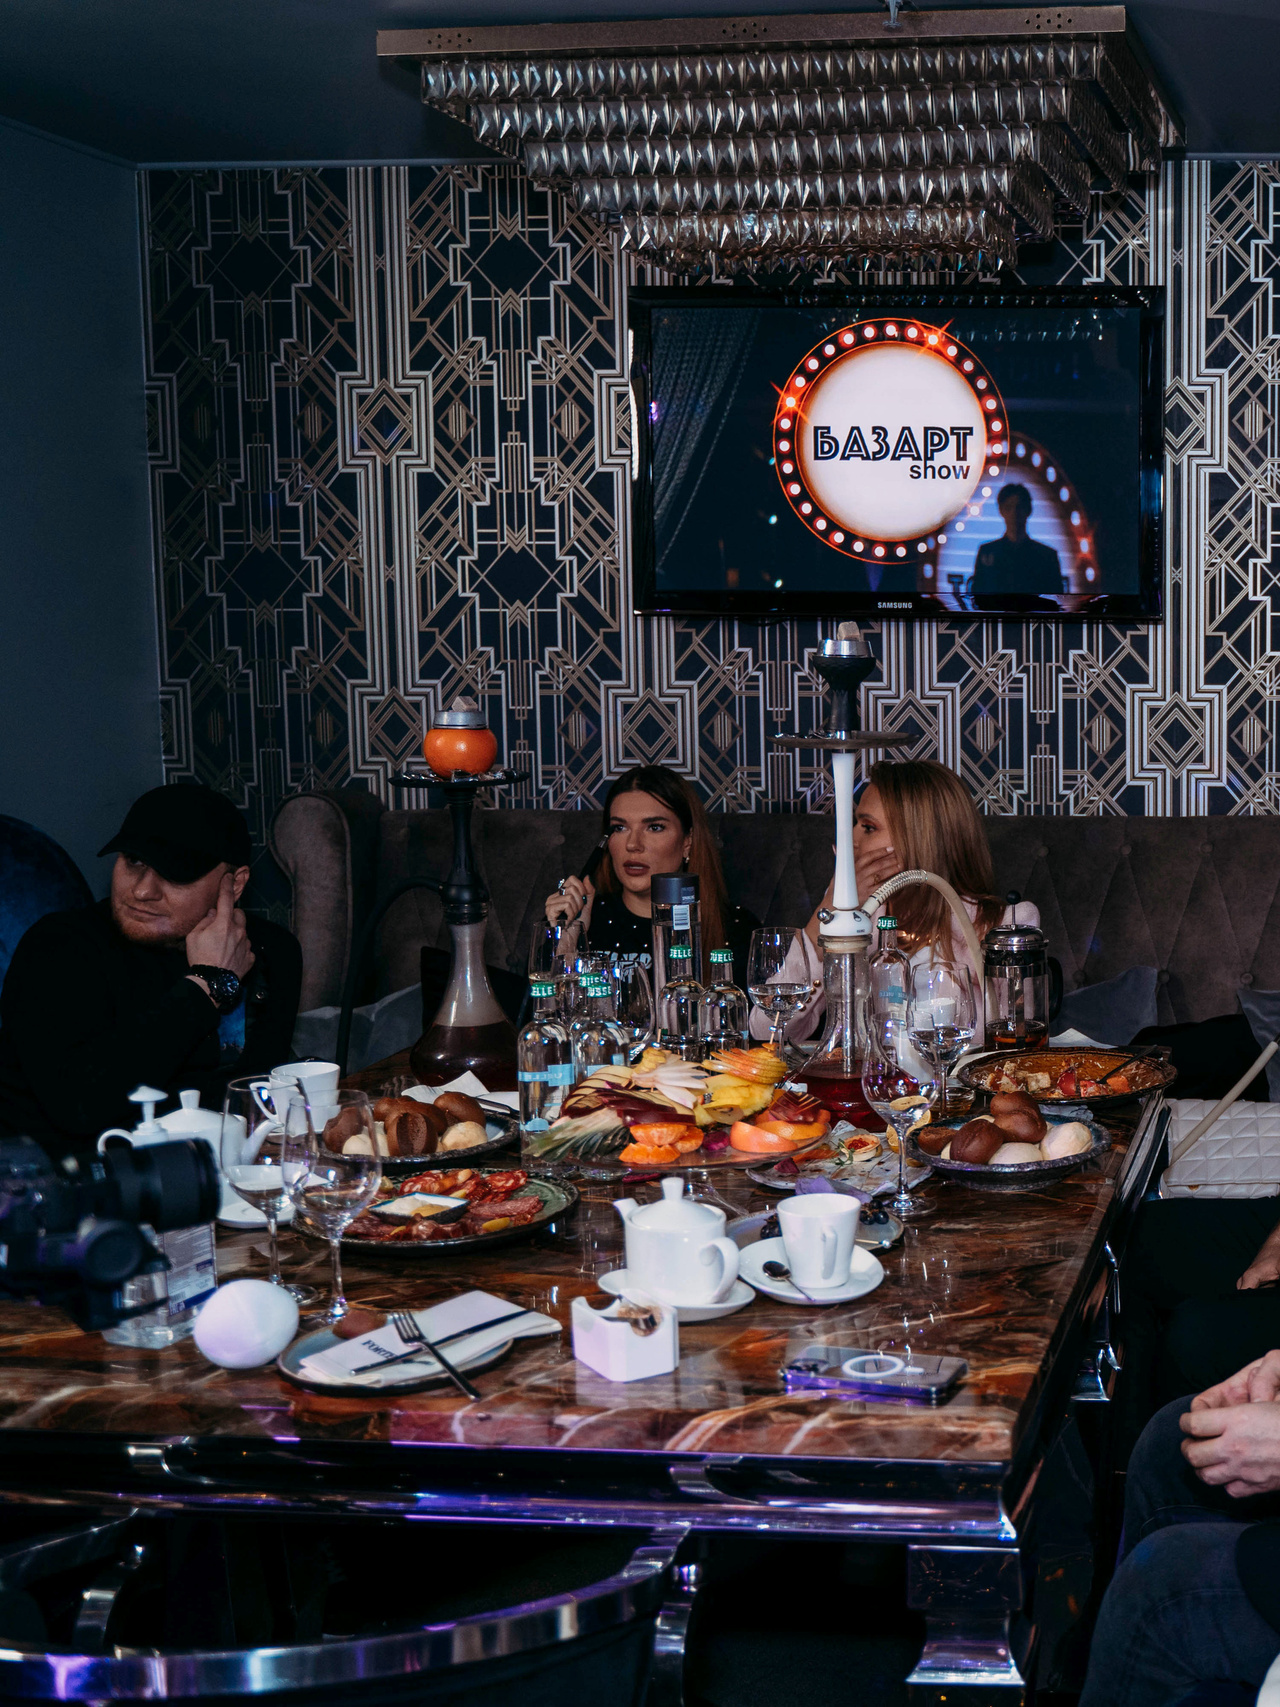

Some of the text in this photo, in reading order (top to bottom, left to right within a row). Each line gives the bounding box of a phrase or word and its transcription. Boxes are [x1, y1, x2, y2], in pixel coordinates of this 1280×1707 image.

[813, 425, 974, 461] БАЗАРТ
[909, 459, 970, 480] show
[877, 601, 913, 609] SAMSUNG
